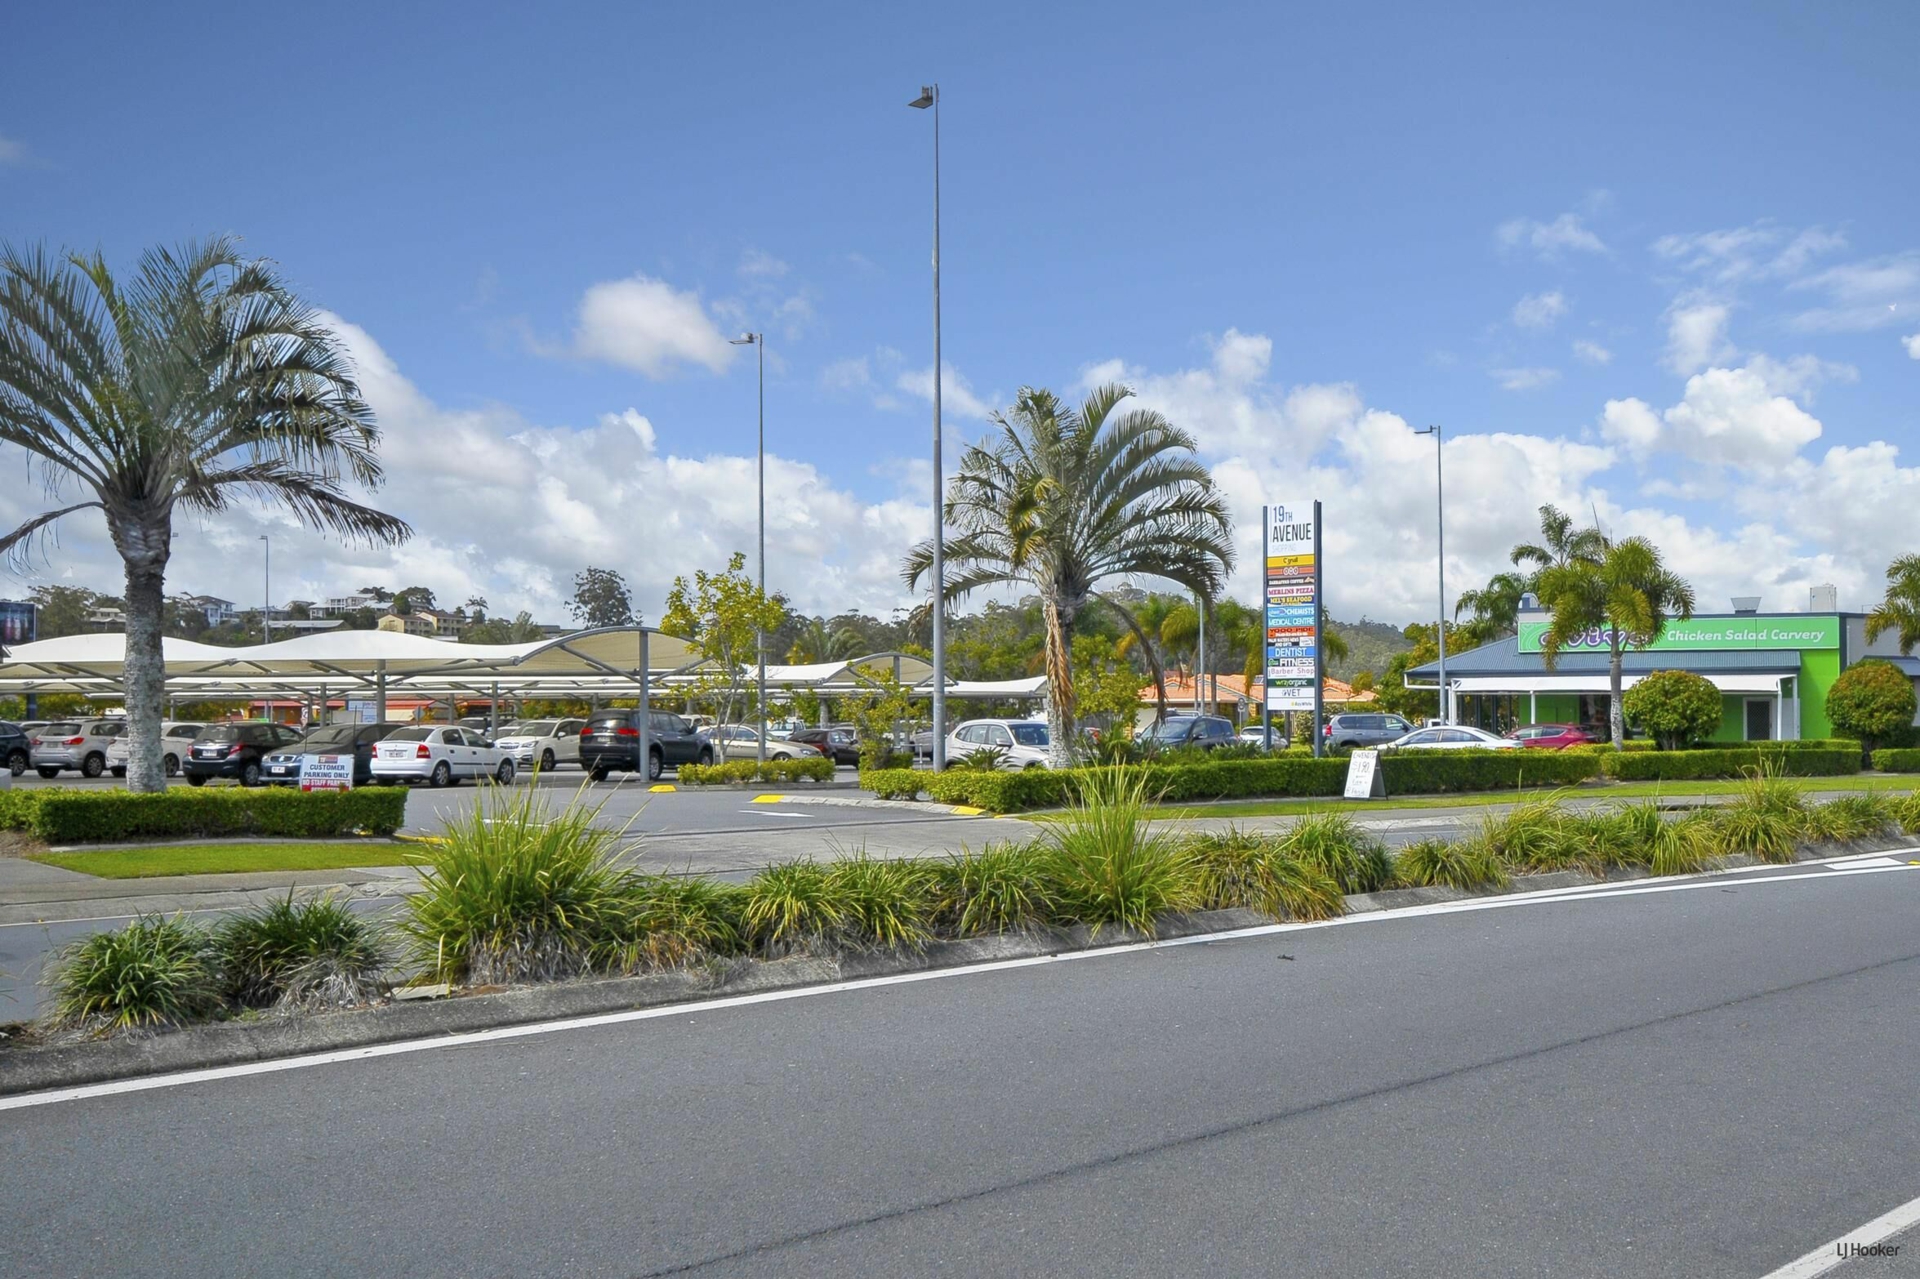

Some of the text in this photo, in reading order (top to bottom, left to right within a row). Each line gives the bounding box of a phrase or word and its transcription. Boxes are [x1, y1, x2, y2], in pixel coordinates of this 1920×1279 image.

[1272, 523, 1312, 542] AVENUE
[1286, 607, 1314, 615] CHEMISTS
[1292, 617, 1314, 625] CENTRE
[1667, 629, 1824, 643] Chicken Salad Carvery
[1275, 647, 1307, 657] DENTIST
[1280, 658, 1314, 667] FITNESS
[1296, 667, 1315, 675] Shop
[1287, 688, 1300, 696] VET
